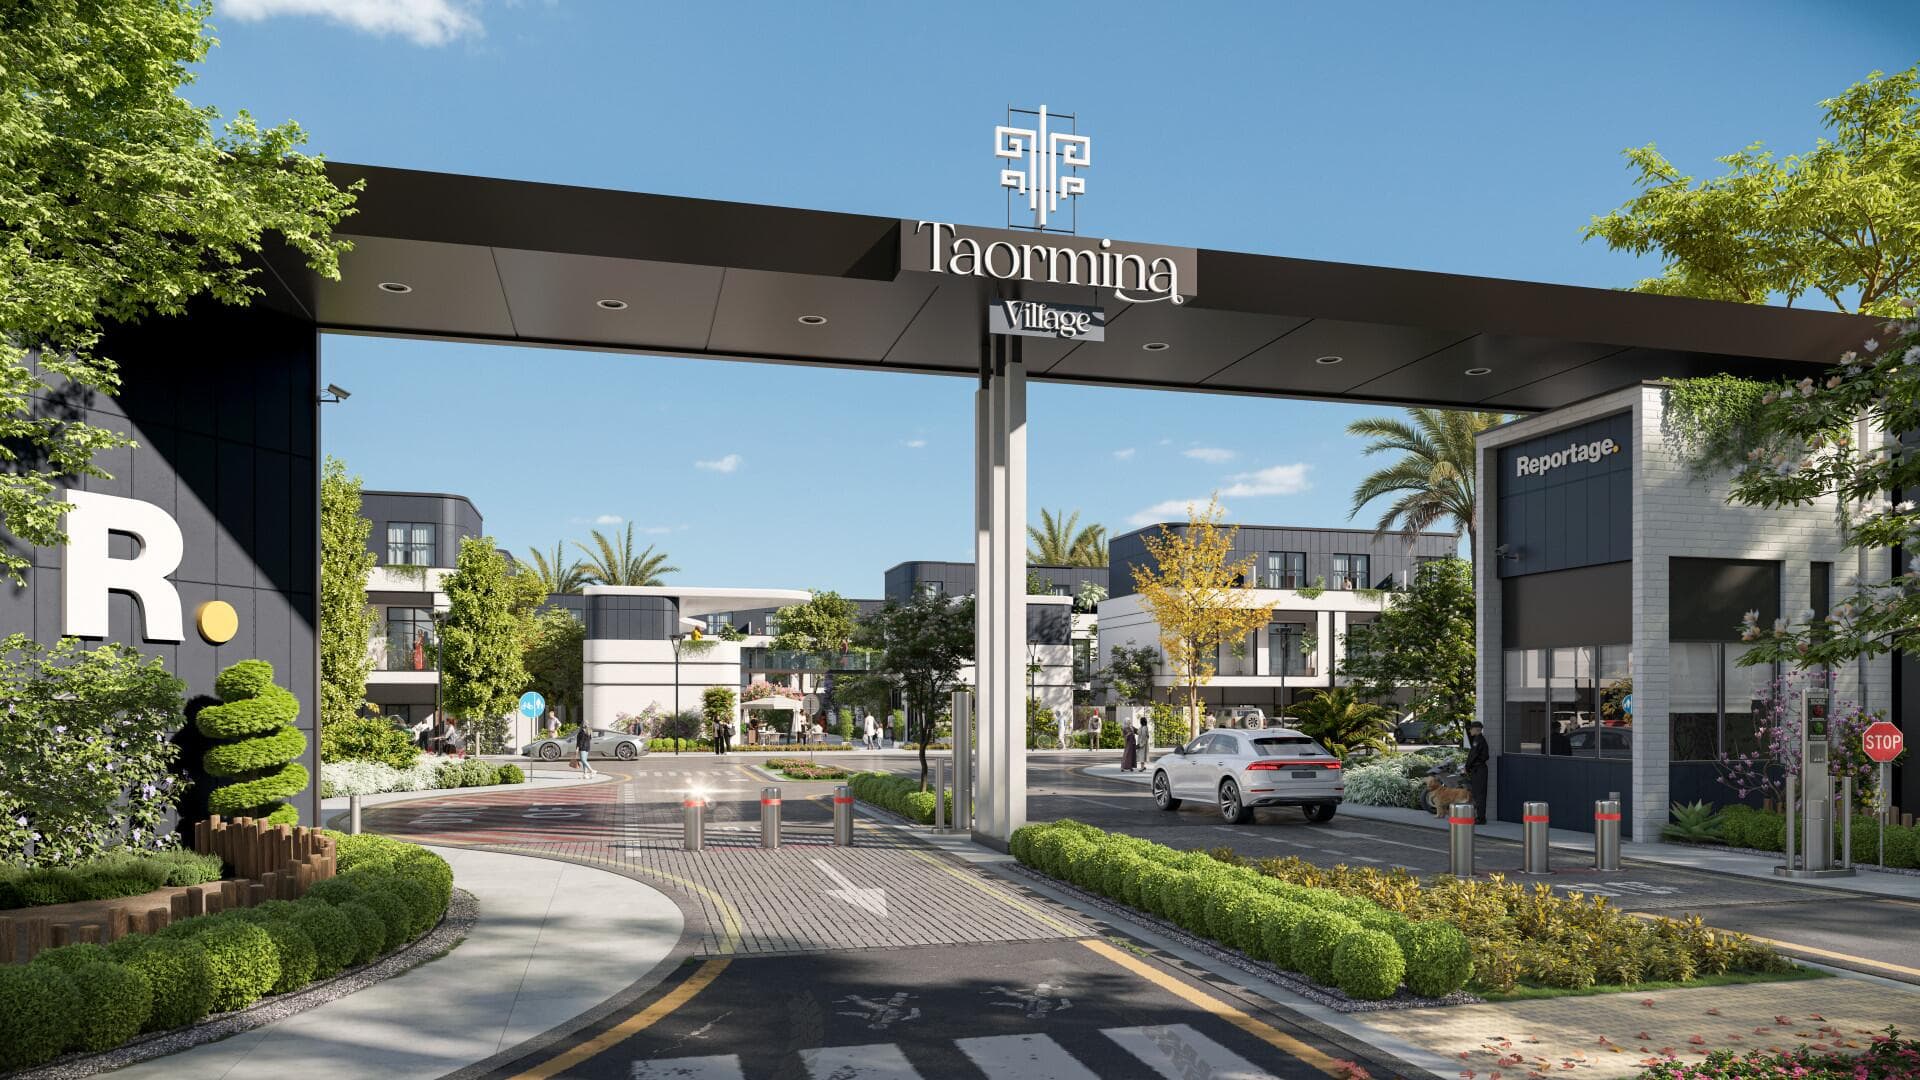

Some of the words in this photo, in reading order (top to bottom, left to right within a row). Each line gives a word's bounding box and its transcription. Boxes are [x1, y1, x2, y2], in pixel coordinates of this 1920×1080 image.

[917, 221, 1184, 304] Taormina
[1004, 300, 1091, 338] Village
[1516, 438, 1619, 476] Reportage.
[1866, 735, 1901, 749] STOP
